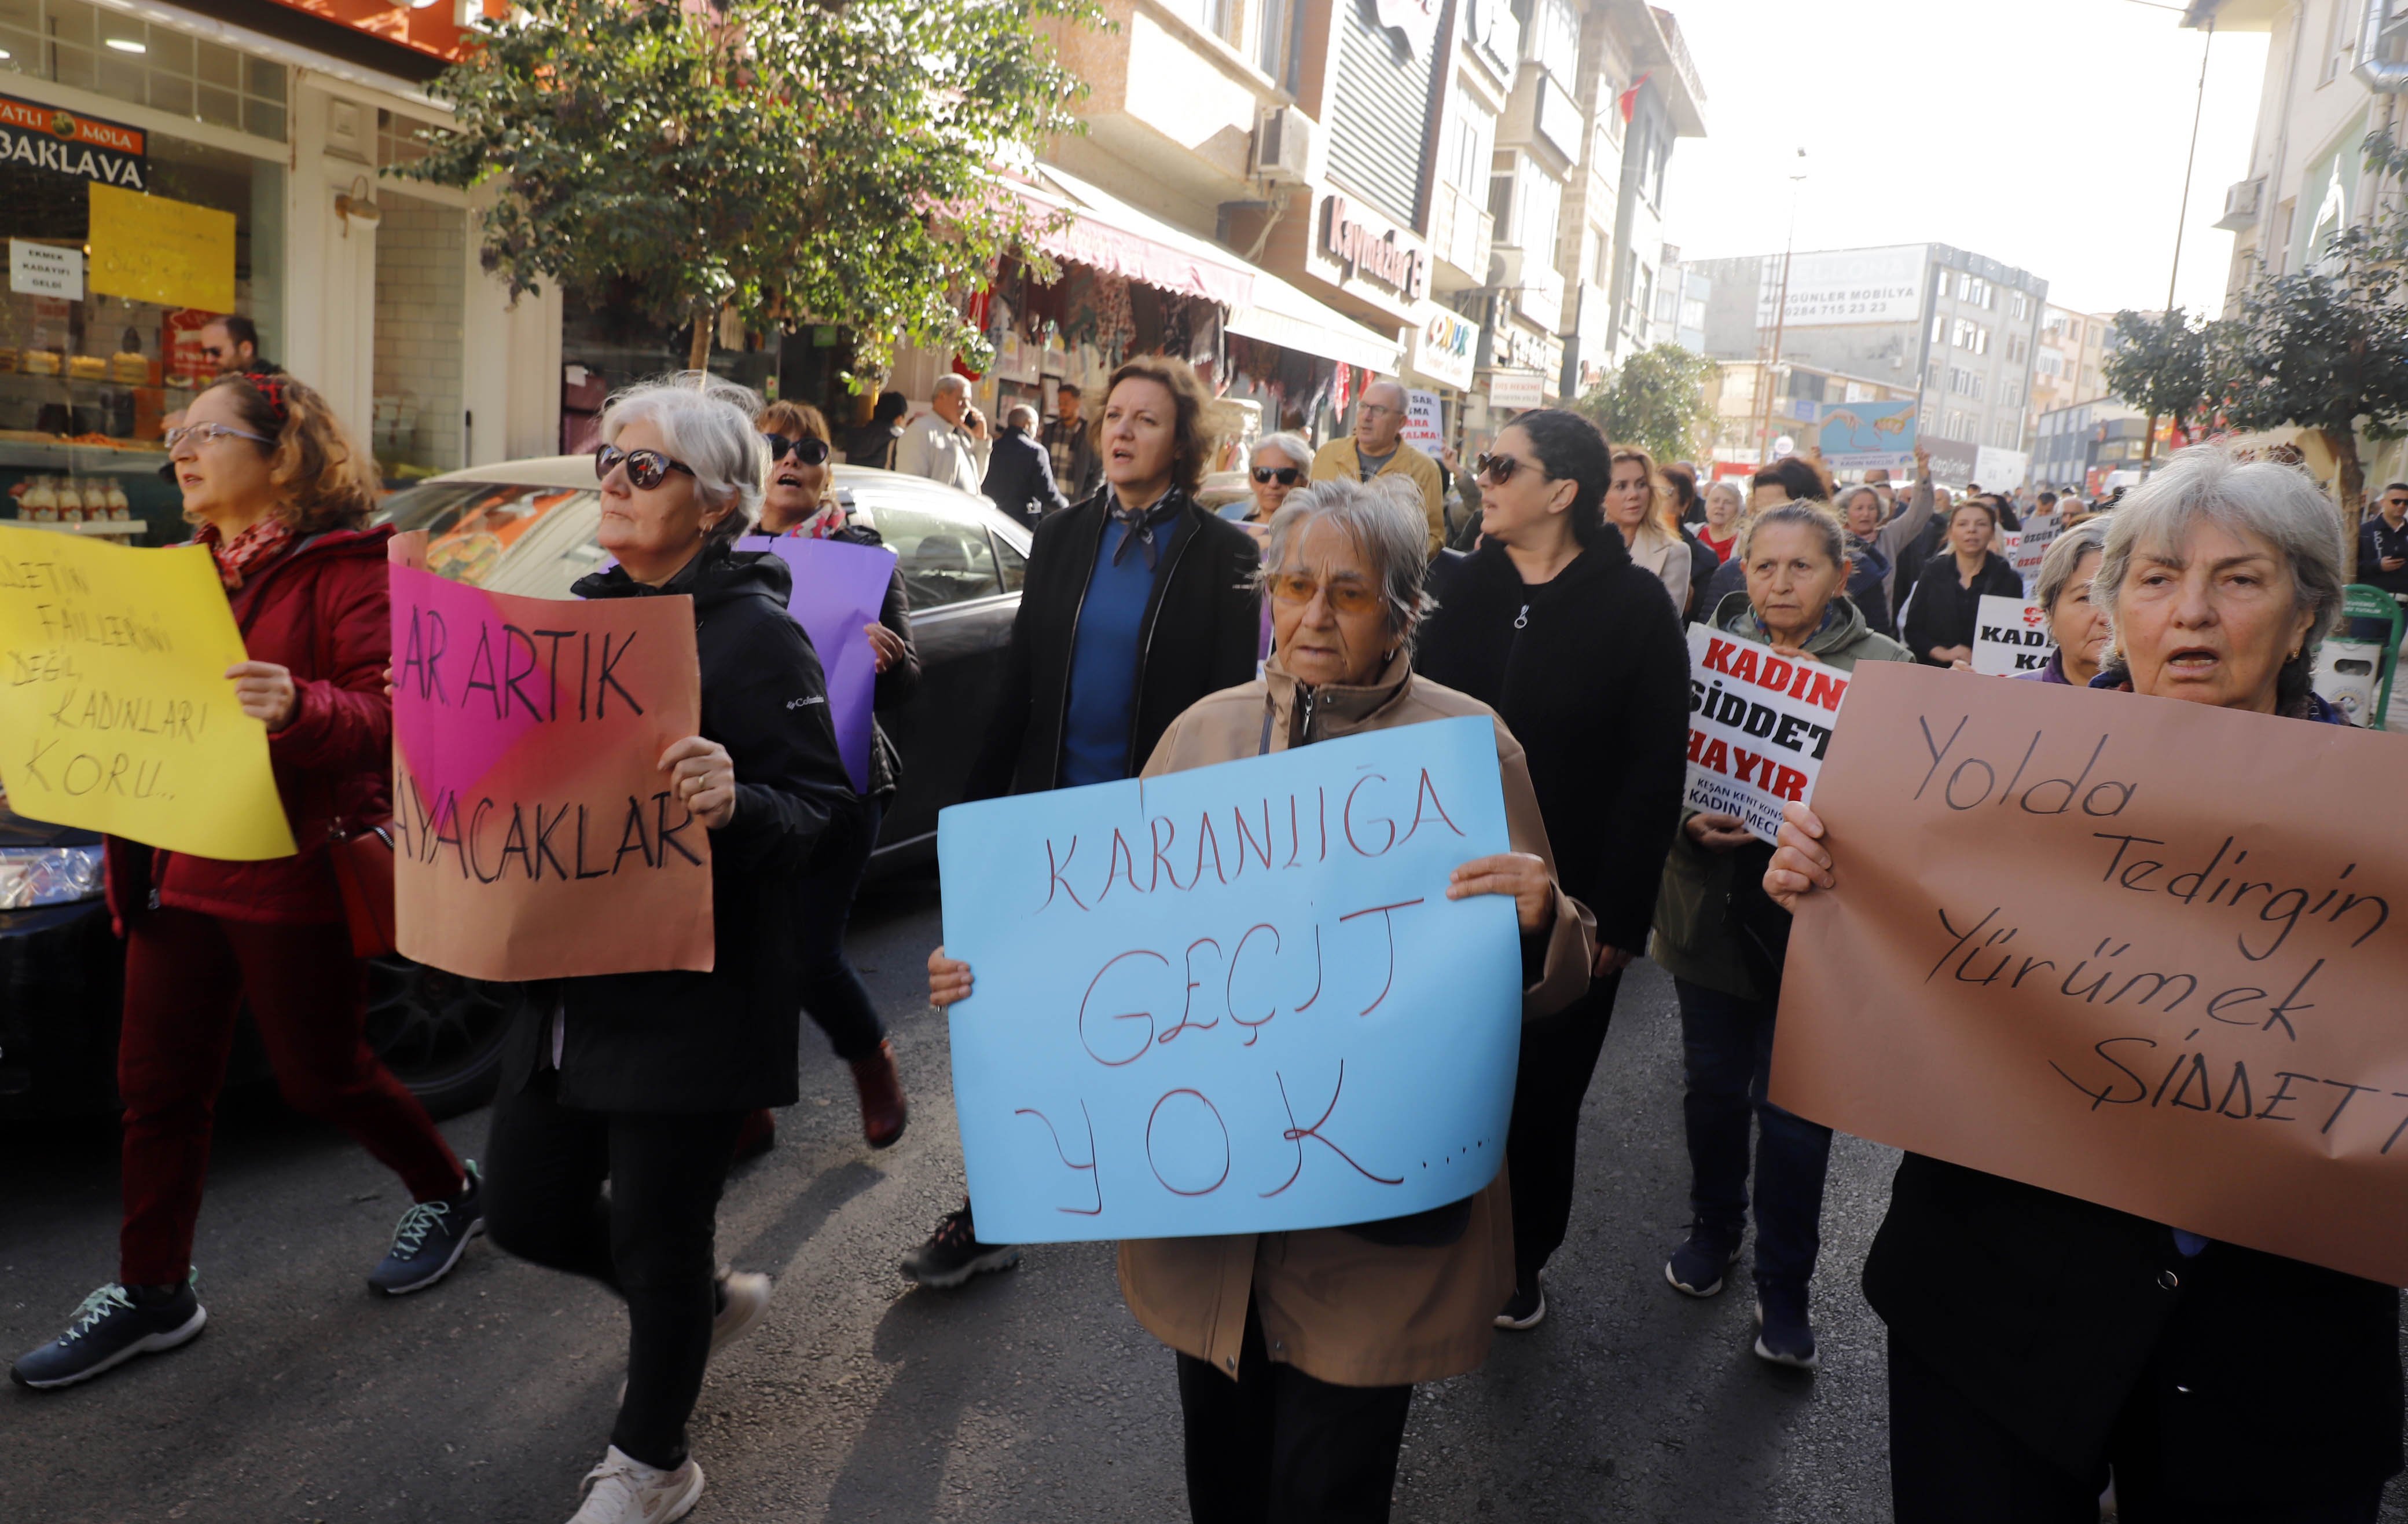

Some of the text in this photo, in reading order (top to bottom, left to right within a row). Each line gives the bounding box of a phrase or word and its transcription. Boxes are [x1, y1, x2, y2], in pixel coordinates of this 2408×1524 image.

[0, 104, 132, 149] ATLI MOLA
[0, 130, 143, 189] BAKLAVA
[29, 250, 63, 261] EKMEK
[1785, 301, 1887, 317] 0284 715 23 23
[1850, 287, 1915, 301] MOBİLYA
[391, 603, 644, 723] AR ARTIK
[50, 688, 208, 744] KADINLARI
[1697, 778, 1731, 797] KEŞAN
[1733, 790, 1758, 808] KENT
[1914, 713, 2138, 817] Yolda
[1689, 788, 1742, 818] KADIN
[2093, 834, 2391, 962] Tedirgin
[1078, 897, 1425, 1065] GEÇİT
[1924, 906, 2326, 1042] Yürümek
